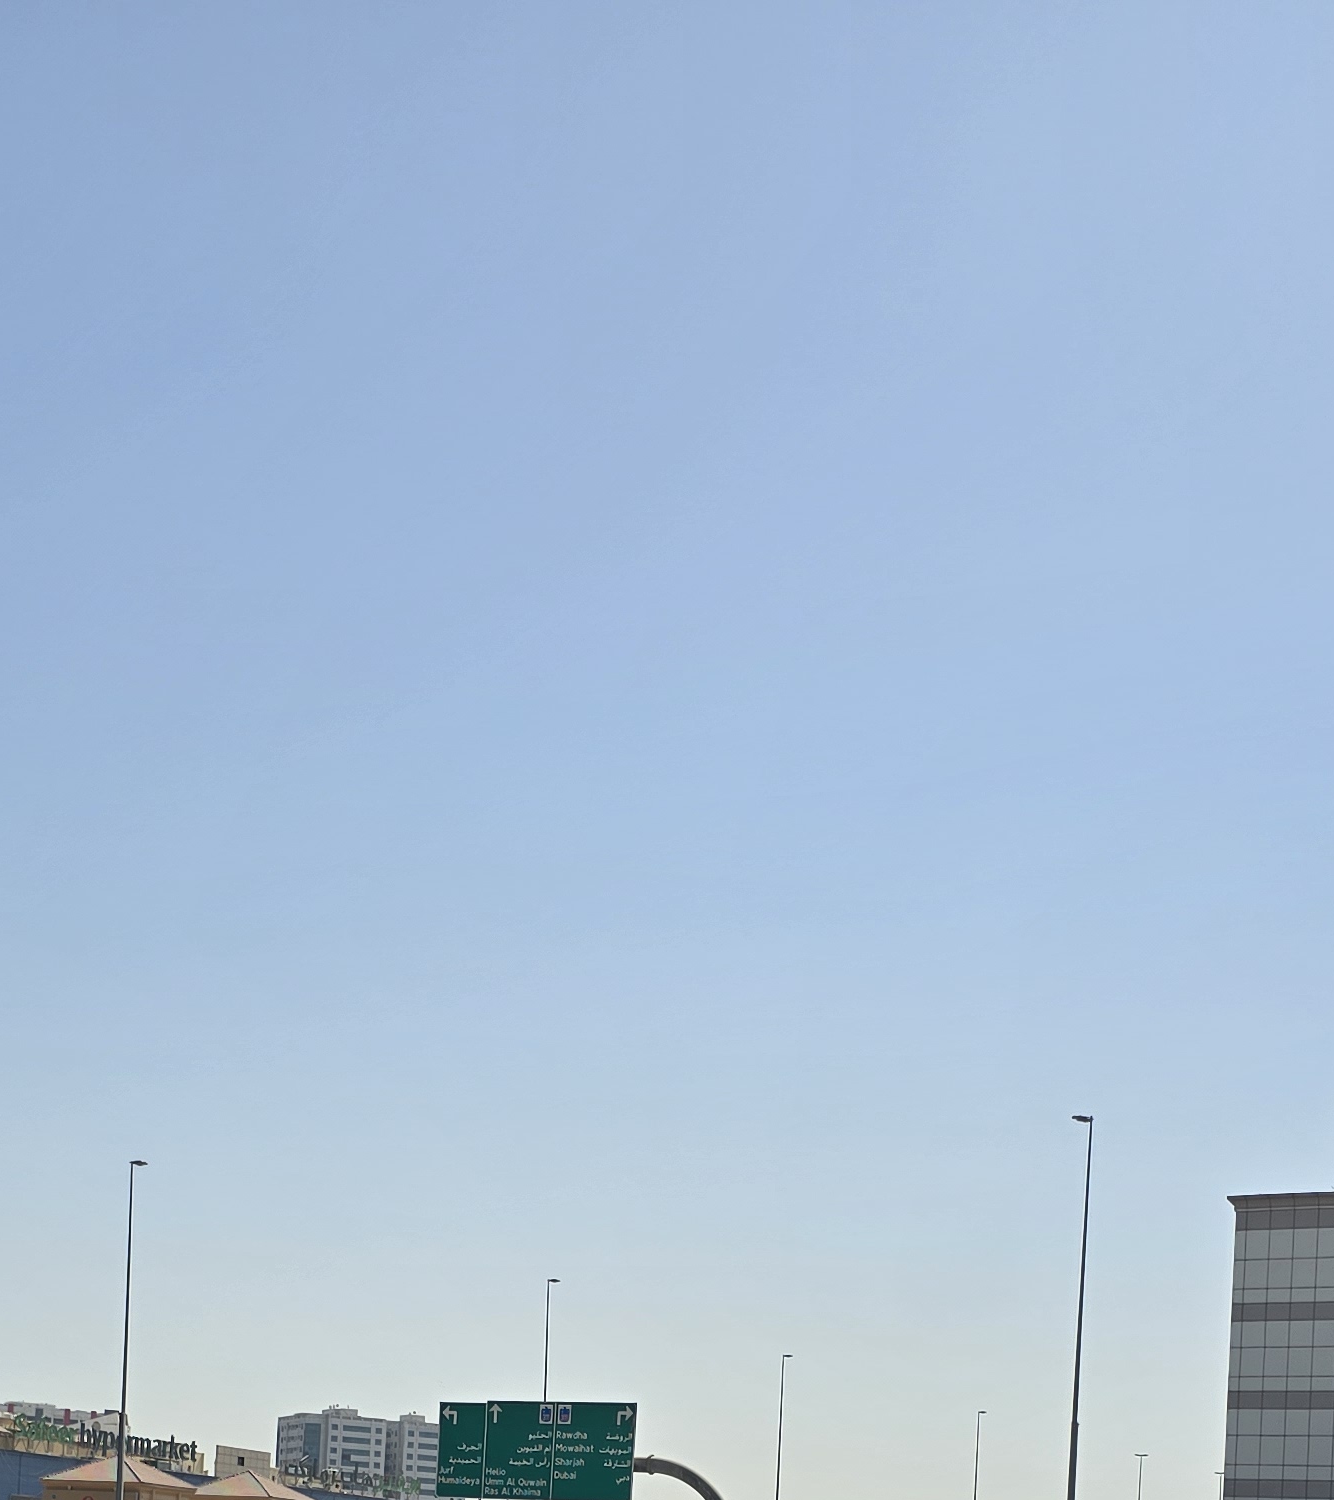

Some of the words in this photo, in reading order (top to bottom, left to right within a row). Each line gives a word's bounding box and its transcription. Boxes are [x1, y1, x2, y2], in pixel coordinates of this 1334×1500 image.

[556, 1430, 588, 1440] Rawdha
[79, 1422, 198, 1462] hyprmarket
[554, 1457, 585, 1467] Sharjah
[485, 1467, 506, 1476] Helio
[553, 1470, 577, 1479] Dubai
[485, 1477, 504, 1486] Umm
[506, 1477, 515, 1486] Al
[517, 1478, 547, 1487] Quwain
[484, 1486, 499, 1495] Ras
[501, 1487, 511, 1496] Al
